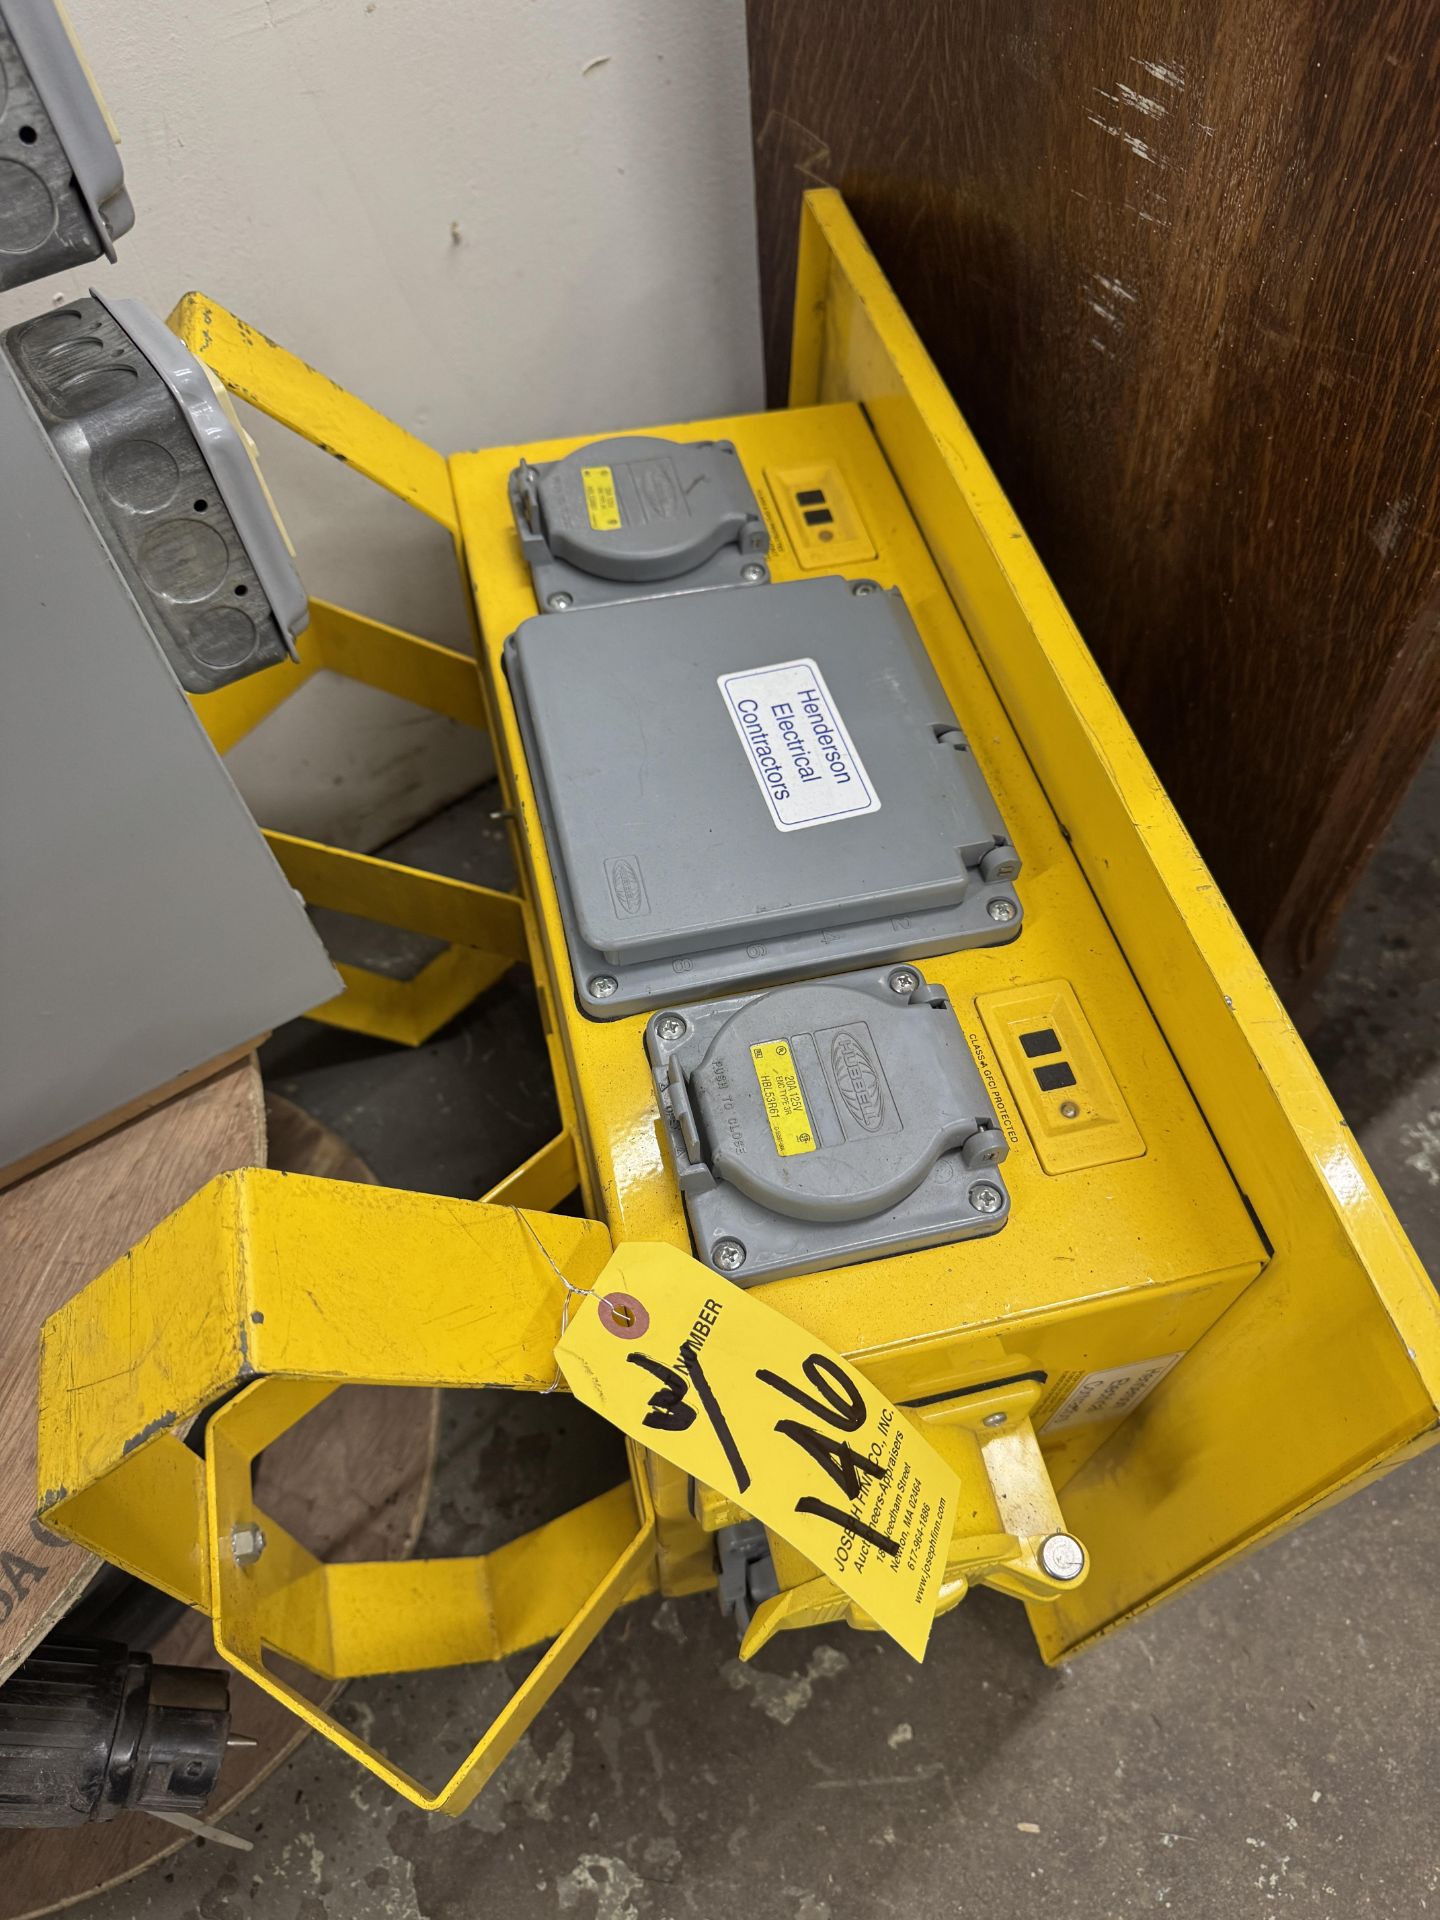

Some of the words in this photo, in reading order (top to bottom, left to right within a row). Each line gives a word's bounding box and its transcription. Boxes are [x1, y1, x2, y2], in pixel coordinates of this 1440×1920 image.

[738, 699, 790, 800] Contractors
[771, 703, 822, 782] Electrical
[797, 689, 851, 784] Henderson
[711, 1060, 729, 1090] PUSH
[721, 1095, 733, 1111] TO
[727, 1117, 747, 1155] CLOSE
[761, 1075, 780, 1119] HBL53R61
[776, 1075, 785, 1089] ENC
[779, 1089, 790, 1106] TYPE
[784, 1076, 796, 1092] 20A
[789, 1091, 804, 1112] 125V
[838, 1040, 881, 1126] HUBBELL
[969, 1033, 985, 1060] CLASS
[983, 1069, 997, 1089] GFCI
[992, 1091, 1018, 1143] PROTECTED
[673, 1298, 722, 1376] NMBER
[755, 1353, 900, 1558] 146
[834, 1503, 863, 1572] JOSEH
[856, 1463, 880, 1507] FIN
[877, 1408, 895, 1438] INC.
[897, 1461, 911, 1494] Street
[853, 1430, 904, 1575] Auctneers-Appraisers
[889, 1530, 910, 1574] Newton,
[902, 1509, 915, 1529] MA
[909, 1479, 923, 1510] 02464
[907, 1502, 931, 1571] 617-964-1886
[914, 1497, 946, 1604] www.josephfinn.com
